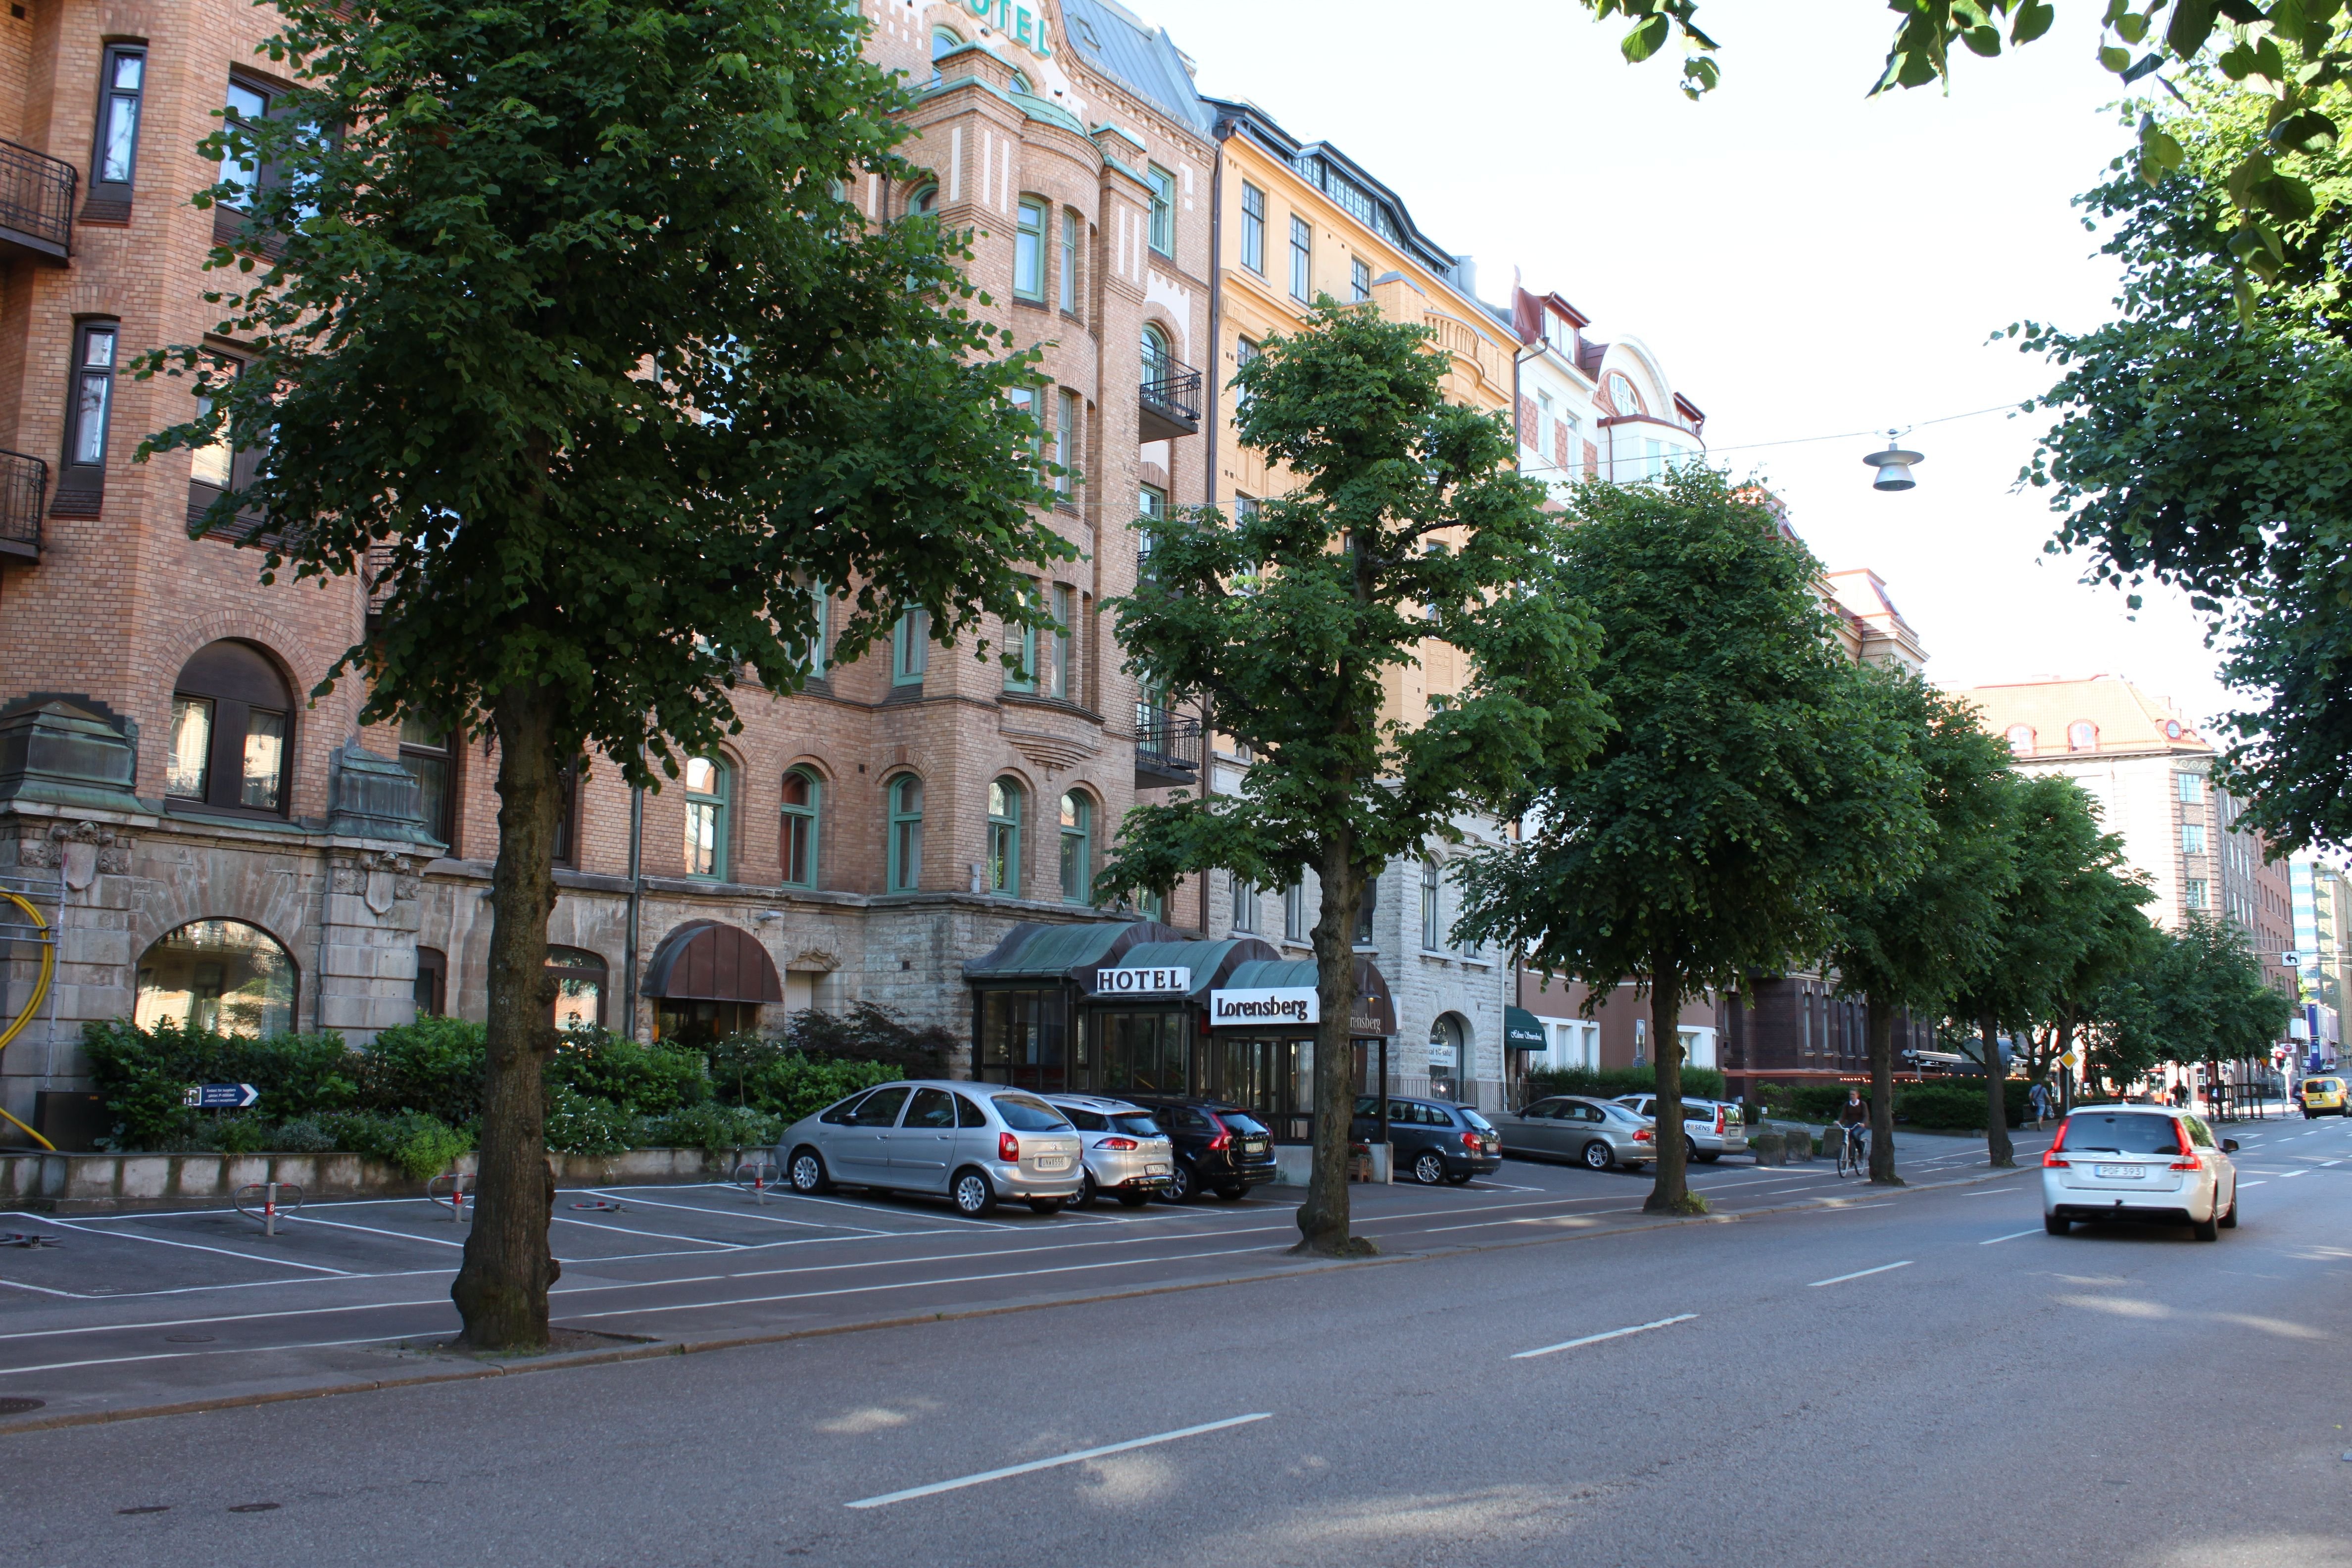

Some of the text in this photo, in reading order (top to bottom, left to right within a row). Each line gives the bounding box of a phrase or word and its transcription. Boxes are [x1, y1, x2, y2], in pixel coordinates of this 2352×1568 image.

[955, 0, 1051, 57] TEL
[1097, 970, 1182, 990] HOTEL
[1217, 995, 1308, 1021] Lorensberg
[1350, 1013, 1381, 1034] rensberg
